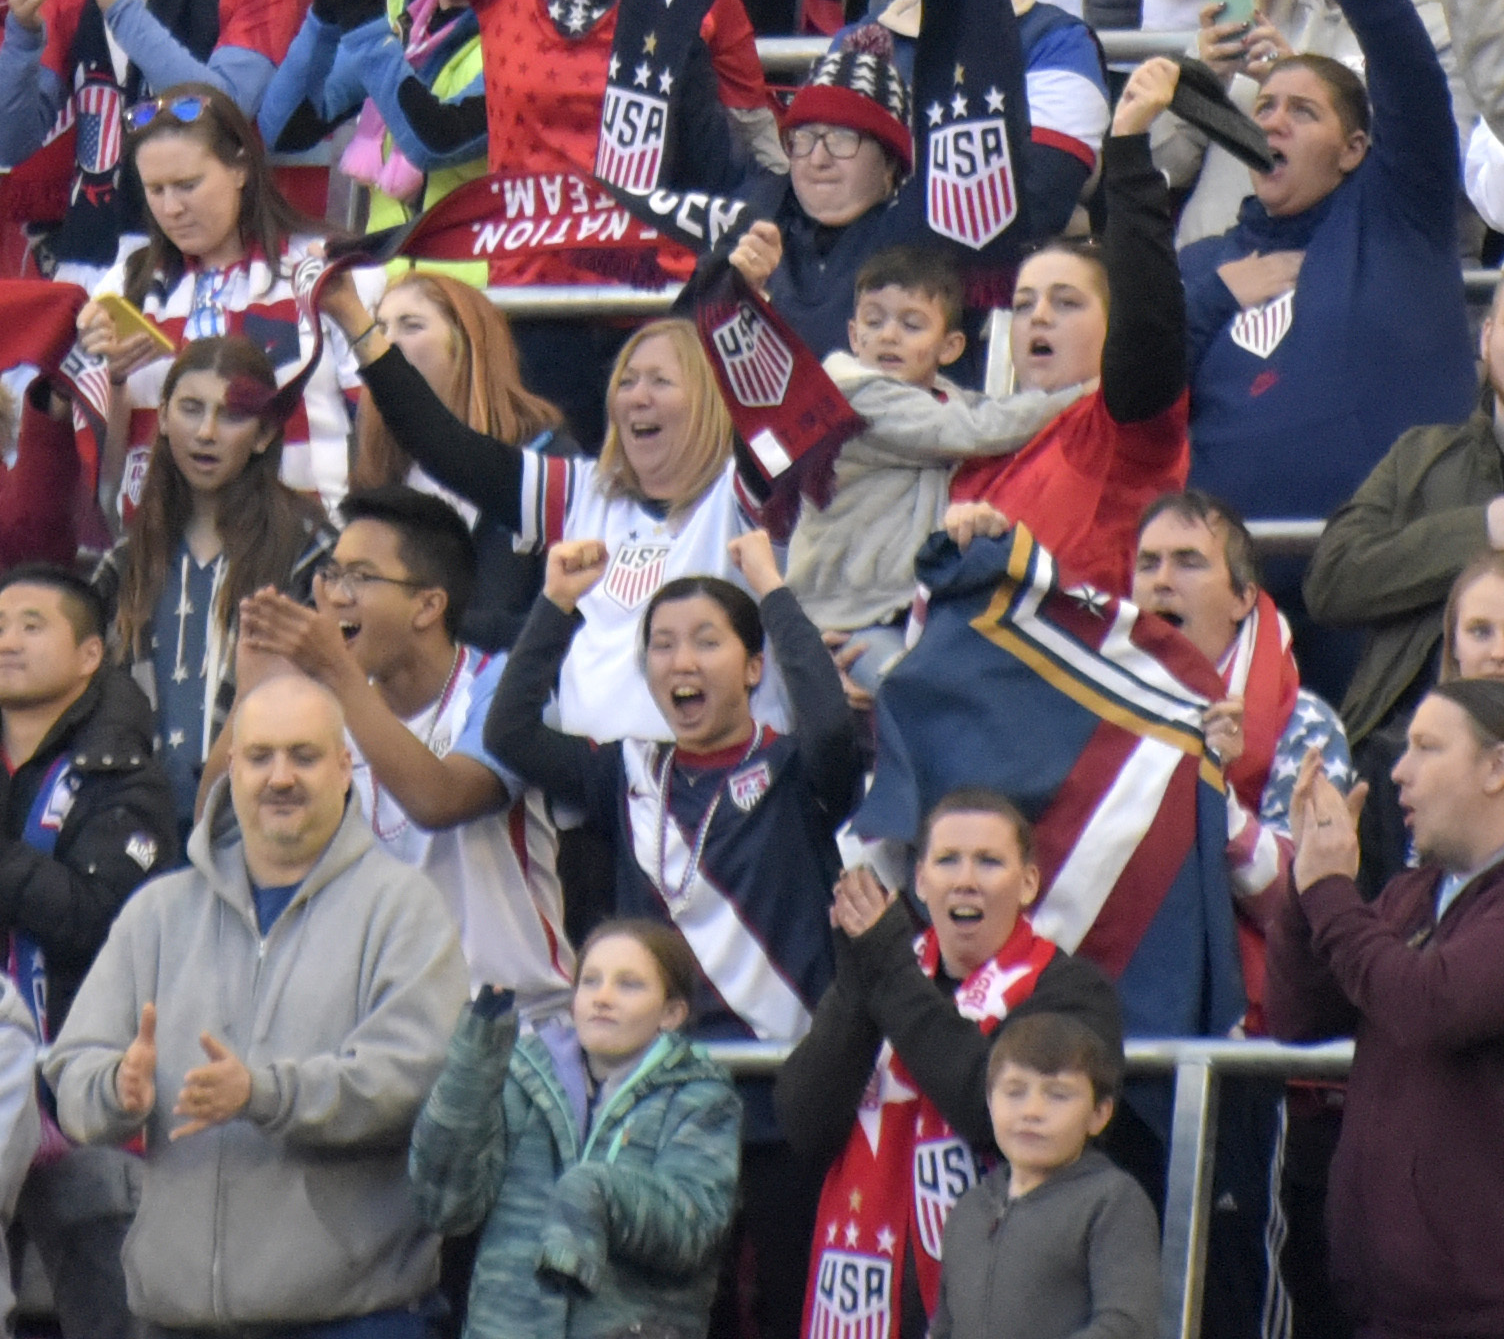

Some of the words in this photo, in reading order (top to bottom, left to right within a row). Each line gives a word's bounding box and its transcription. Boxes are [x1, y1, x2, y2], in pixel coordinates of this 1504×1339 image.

[603, 92, 665, 149] USA
[933, 127, 1004, 179] USA
[490, 172, 615, 219] TEAM.
[470, 212, 631, 256] NATION.
[619, 548, 670, 569] USA
[917, 1145, 970, 1200] US
